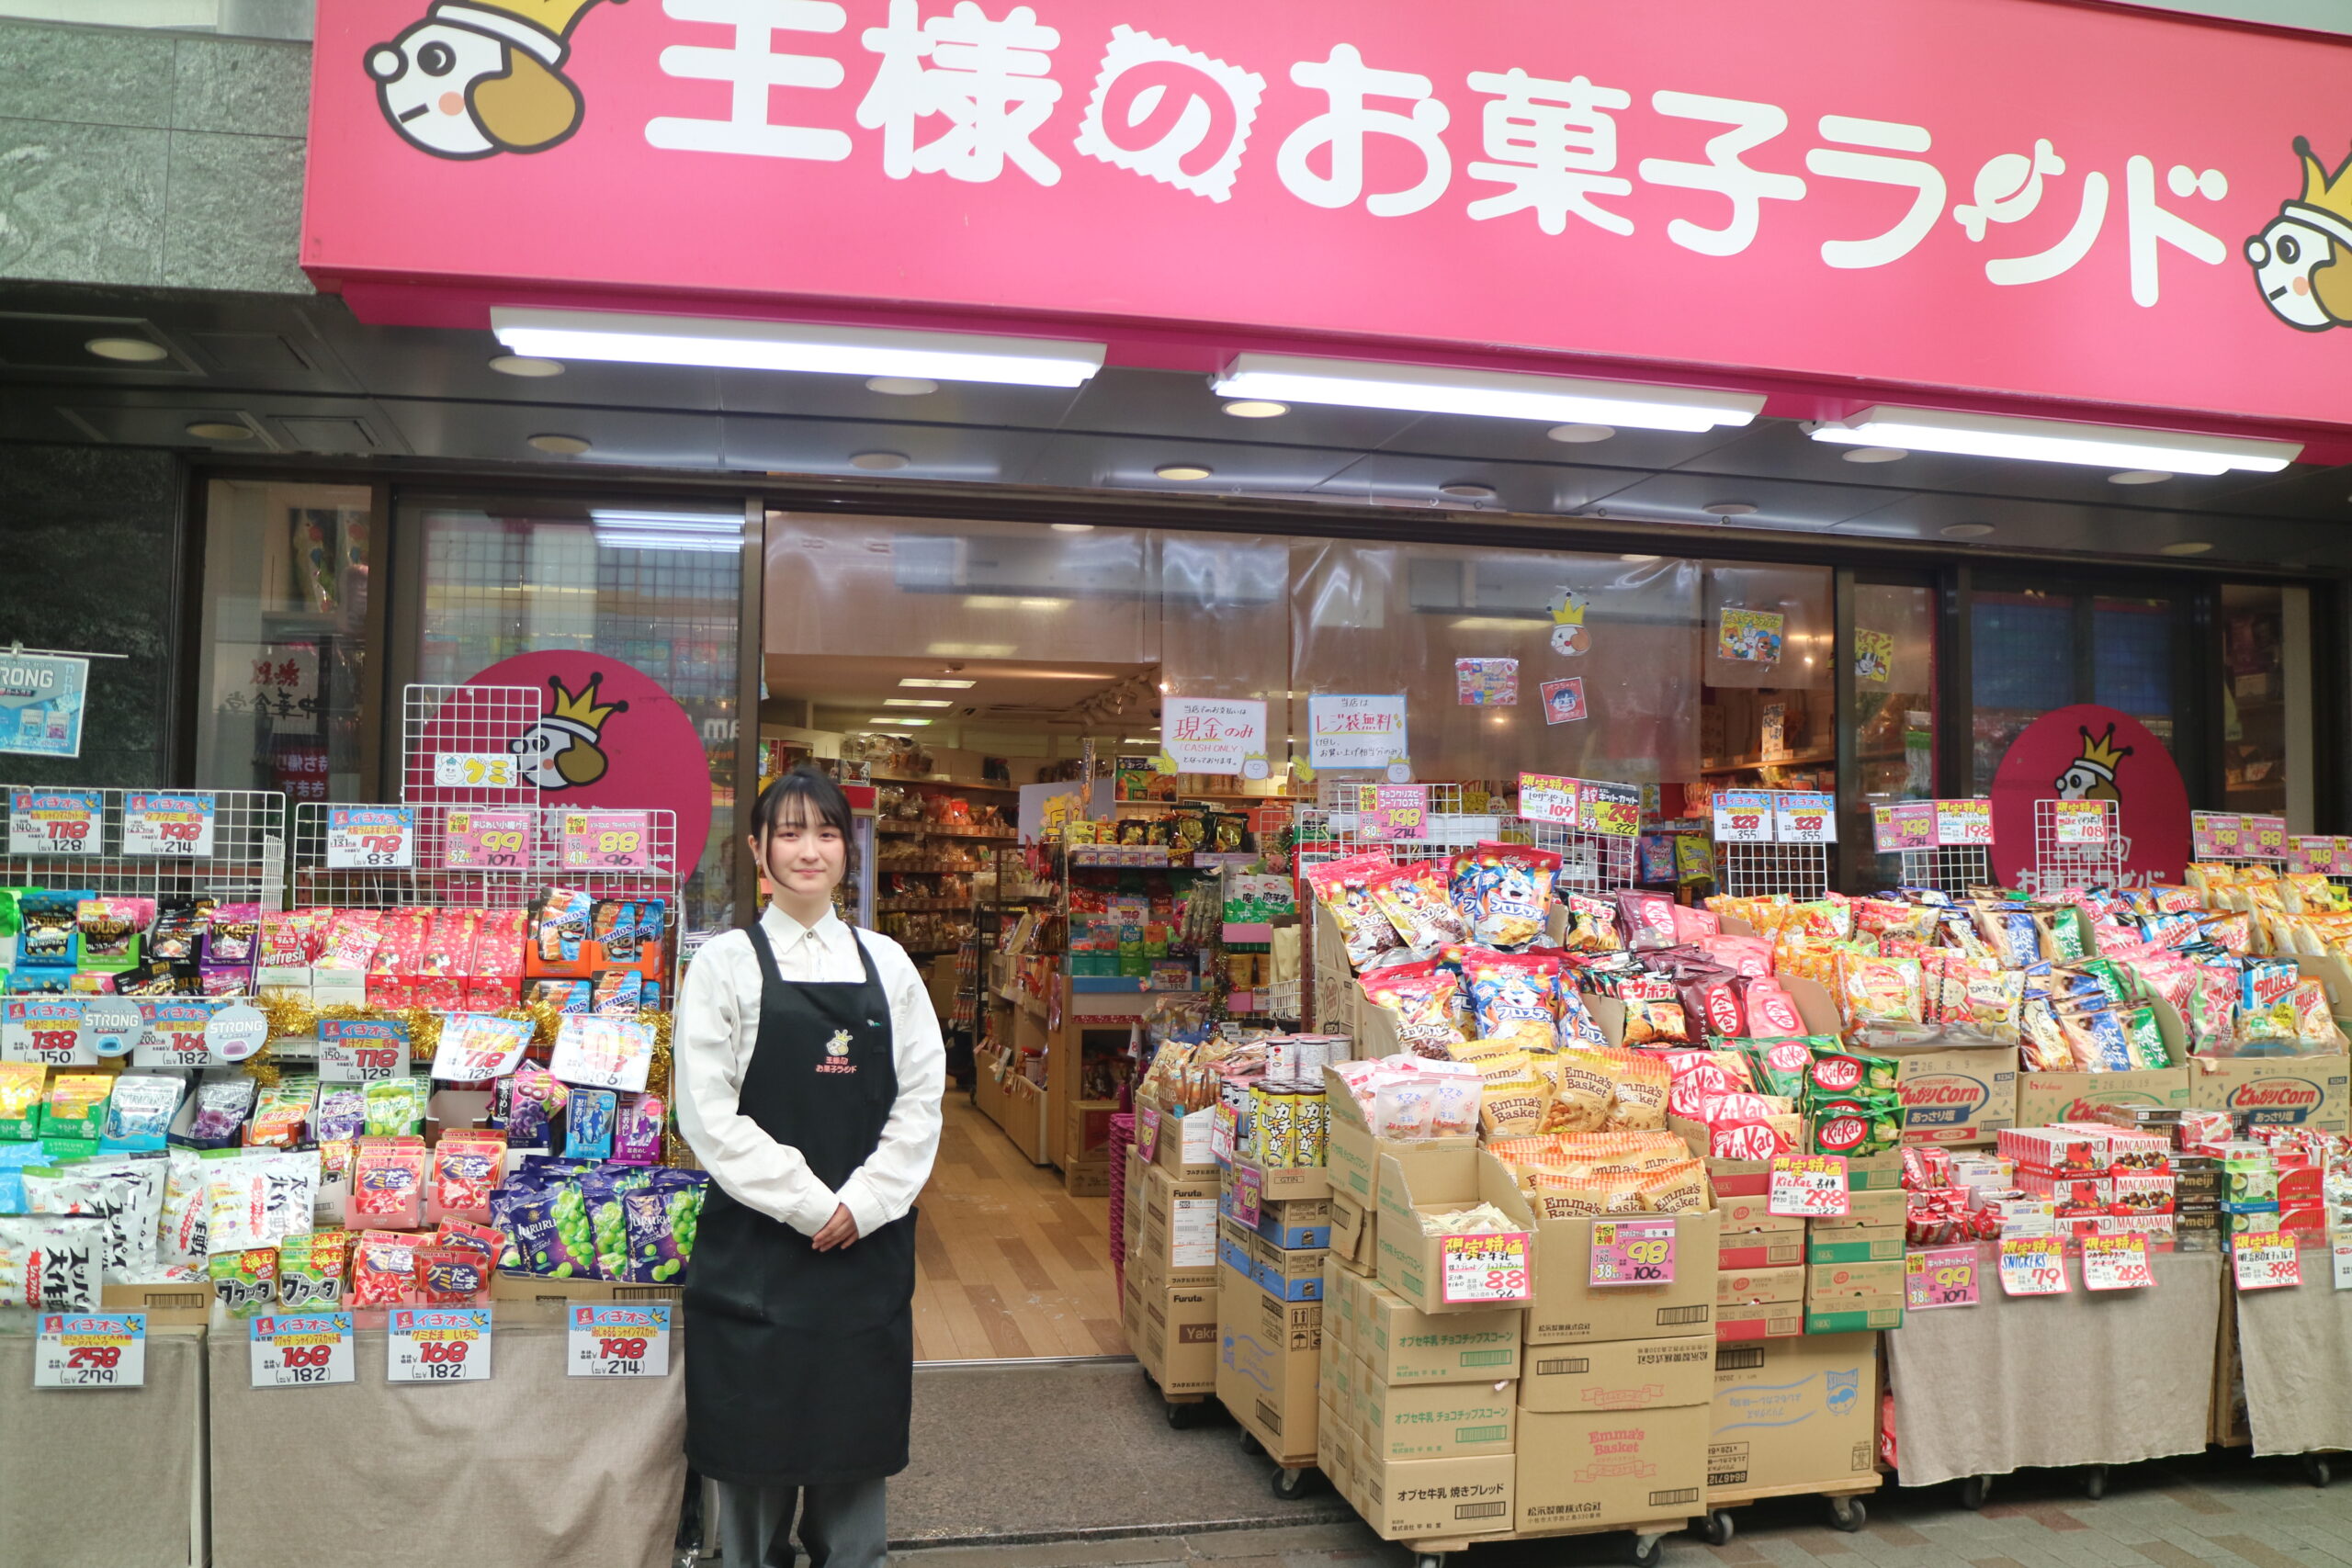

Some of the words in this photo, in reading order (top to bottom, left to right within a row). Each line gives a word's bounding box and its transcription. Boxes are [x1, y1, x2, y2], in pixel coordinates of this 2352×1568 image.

[644, 0, 2228, 308] 王様のお菓子ランド
[1341, 698, 1369, 707] 当店は
[1172, 716, 1254, 741] 現金のみ
[1317, 713, 1391, 733] レジ袋無料
[464, 758, 509, 784] グミ
[1380, 790, 1424, 798] チョコクリスピー
[1599, 793, 1638, 805] キットカット
[144, 813, 178, 821] タフグミ
[1388, 808, 1421, 827] 198
[1549, 804, 1574, 817] 109
[1609, 804, 1639, 823] 298
[47, 820, 90, 839] 118
[1614, 823, 1636, 835] 322
[1732, 815, 1759, 829] 328
[1794, 817, 1823, 830] 328
[1902, 818, 1930, 837] 198
[160, 822, 202, 840] 198
[1394, 829, 1417, 839] 214
[1737, 829, 1757, 840] 355
[1801, 831, 1821, 840] 355
[1964, 825, 1991, 838] 198
[2082, 826, 2103, 838] 108
[2214, 830, 2238, 846] 198
[2260, 830, 2282, 847] 88
[51, 840, 82, 852] 128
[164, 841, 194, 853] 214
[362, 836, 401, 852] 78
[481, 831, 524, 852] 99
[599, 831, 640, 852] 88
[368, 853, 395, 864] 83
[487, 854, 515, 865] 107
[605, 854, 632, 865] 96
[543, 908, 586, 929] mentos
[1490, 900, 1544, 921] フロスティ
[2254, 975, 2297, 998] Mike
[1498, 1006, 1552, 1025] フロスティ
[1712, 988, 1736, 1034] KitKat
[85, 1014, 139, 1027] STRONG
[209, 1021, 263, 1034] STRONG
[31, 1031, 76, 1049] 138
[339, 1039, 373, 1047] 果汁グミ
[40, 1051, 71, 1064] 150
[178, 1052, 208, 1065] 182
[356, 1049, 399, 1067] 118
[465, 1050, 505, 1067] 118
[361, 1068, 390, 1079] 128
[1564, 1066, 1612, 1090] Emma's
[1820, 1061, 1857, 1082] KitKat
[1566, 1078, 1609, 1099] Basket
[2234, 1084, 2316, 1106] とんがりCorn
[1487, 1096, 1543, 1116] Emma's
[261, 1111, 301, 1122] 果汁グミ
[1496, 1107, 1540, 1122] Basket
[1911, 1110, 1955, 1122] あっさり塩
[2255, 1111, 2295, 1124] あっさり塩
[1826, 1122, 1860, 1145] KitKat
[1723, 1127, 1772, 1159] KitKat
[2115, 1138, 2168, 1151] MACADAMIA
[440, 1154, 489, 1179] グミだま
[1774, 1156, 1842, 1177] 限定特価
[363, 1168, 413, 1190] グミだま
[1776, 1176, 1812, 1188] KitKat
[2119, 1178, 2173, 1191] MACADAMIA
[2185, 1175, 2214, 1188] meiji
[1173, 1190, 1202, 1198] Furuta
[1654, 1183, 1701, 1212] Emma's
[1804, 1189, 1845, 1207] 298
[1544, 1197, 1601, 1215] Emma's
[2117, 1215, 2171, 1229] MACADAMIA
[2186, 1213, 2214, 1227] meiji
[1445, 1235, 1524, 1258] 限定特価
[1627, 1239, 1669, 1265] 98
[2002, 1238, 2062, 1257] 限定特価
[2085, 1235, 2144, 1254] 限定特価
[1928, 1257, 1974, 1268] キットカットバー
[2001, 1253, 2048, 1269] SNICKERS
[2267, 1260, 2296, 1278] 398
[428, 1266, 479, 1292] グミだま
[1485, 1269, 1525, 1289] 88
[1634, 1266, 1661, 1280] 106
[1935, 1266, 1972, 1289] 99
[2031, 1268, 2061, 1285] 79
[2115, 1265, 2148, 1280] 268
[281, 1274, 337, 1301] ググッタ
[1496, 1289, 1515, 1298] 96
[1173, 1295, 1203, 1303] Furuta
[1942, 1290, 1967, 1303] 107
[412, 1331, 446, 1340] グミだま
[453, 1330, 480, 1340] いちご
[1399, 1334, 1438, 1348] オブセ牛乳
[1441, 1332, 1513, 1346] チョコチップスコーン
[420, 1341, 469, 1363] 168
[600, 1337, 648, 1359] 198
[67, 1347, 121, 1368] 258
[282, 1345, 331, 1368] 168
[292, 1368, 326, 1382] 182
[428, 1364, 461, 1379] 182
[608, 1360, 640, 1374] 214
[78, 1370, 114, 1383] 279
[1395, 1411, 1433, 1425] オブセ牛乳
[1437, 1407, 1508, 1423] チョコチップスコーン
[1588, 1428, 1645, 1444] Emma's
[1594, 1441, 1639, 1456] Basket
[1397, 1487, 1447, 1502] オブセ牛乳
[1451, 1483, 1505, 1498] 焼きブレッド
